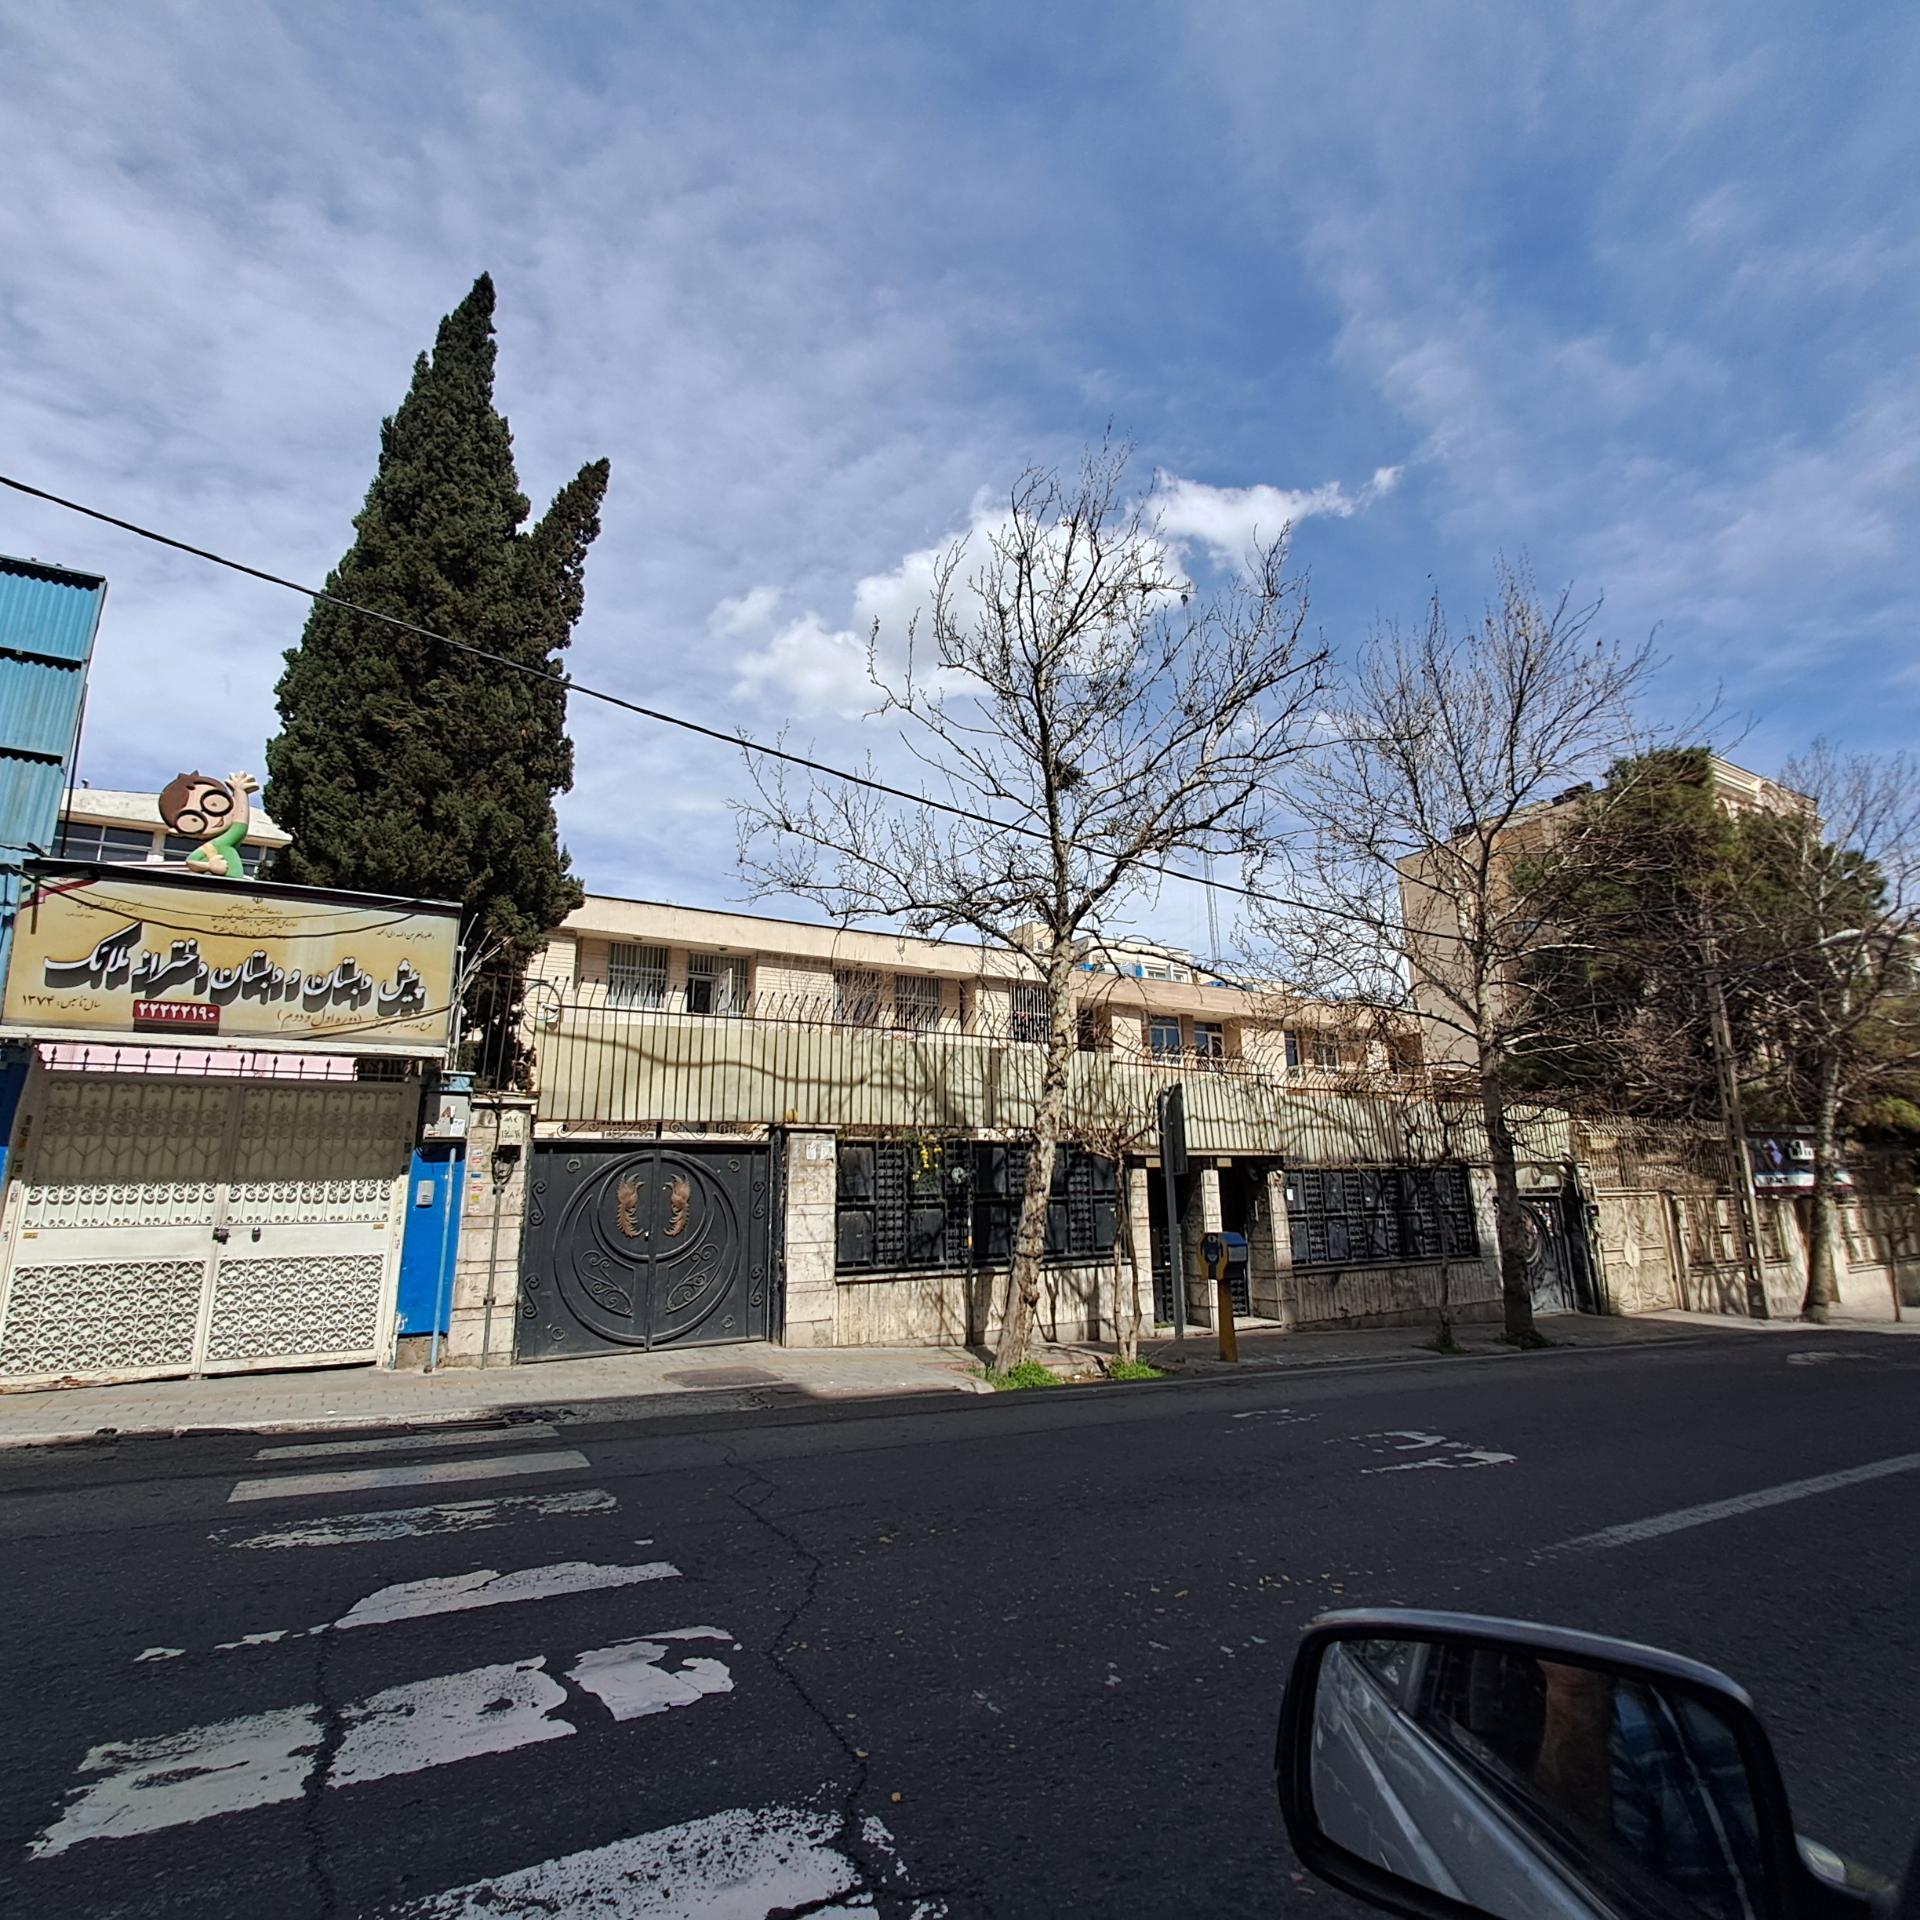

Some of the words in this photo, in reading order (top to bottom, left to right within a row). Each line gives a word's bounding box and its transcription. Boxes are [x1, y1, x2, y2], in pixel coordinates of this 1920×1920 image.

[130, 938, 208, 984] دخترانه
[210, 950, 284, 989] دبستان
[285, 969, 300, 986] و
[303, 957, 372, 996] دبستان
[379, 957, 426, 1003] پیش
[83, 1000, 102, 1011] سال
[138, 1002, 216, 1020] ۲۲۲۲۲۱۹۰
[310, 1008, 336, 1027] اول
